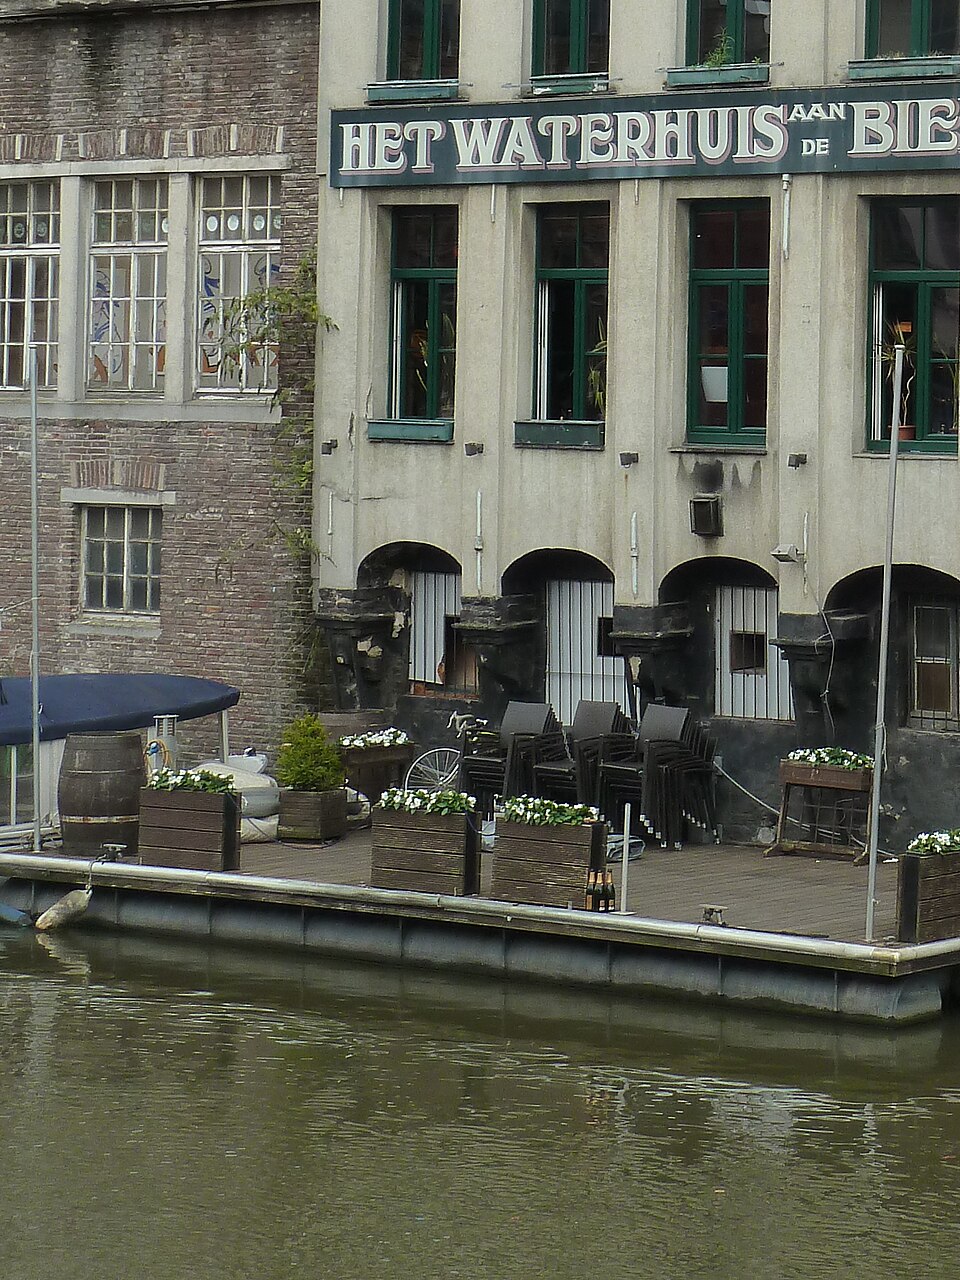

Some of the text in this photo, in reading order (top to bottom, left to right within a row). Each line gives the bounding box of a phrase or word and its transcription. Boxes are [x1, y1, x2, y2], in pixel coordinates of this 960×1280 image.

[338, 120, 446, 175] HET
[448, 103, 789, 173] WATERHUIS
[788, 102, 847, 121] AAN
[801, 138, 829, 156] DE
